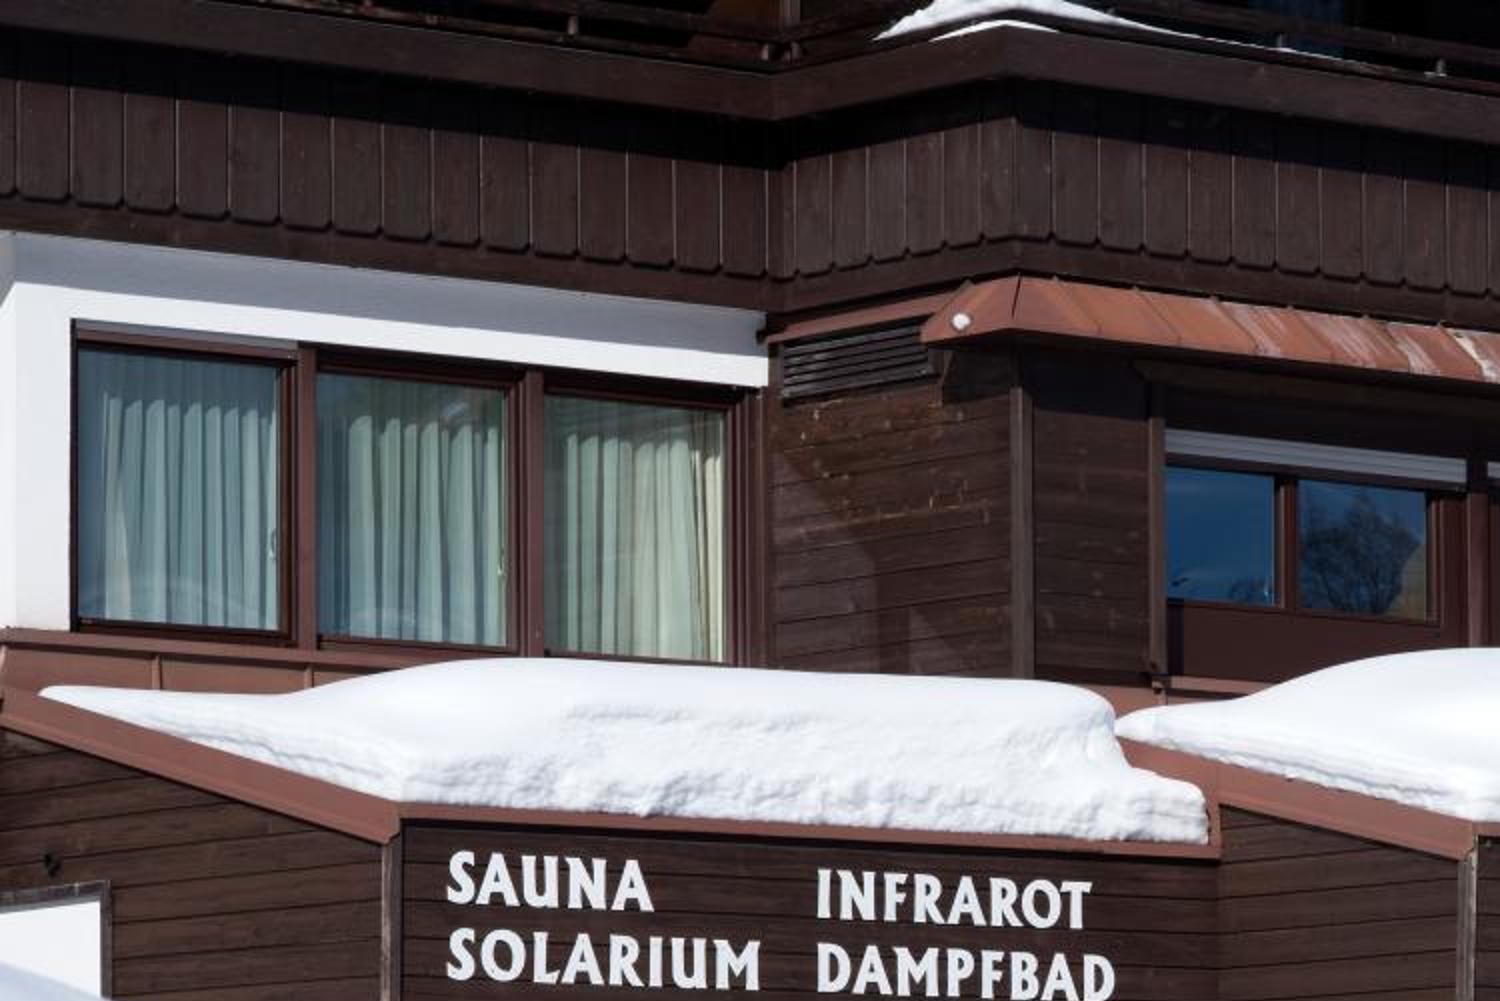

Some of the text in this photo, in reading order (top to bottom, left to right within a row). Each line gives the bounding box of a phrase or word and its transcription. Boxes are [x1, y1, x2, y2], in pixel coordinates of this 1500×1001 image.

[446, 850, 655, 914] SAUNA
[817, 868, 1093, 931] INFRAROT
[446, 927, 761, 992] SOLARIUM
